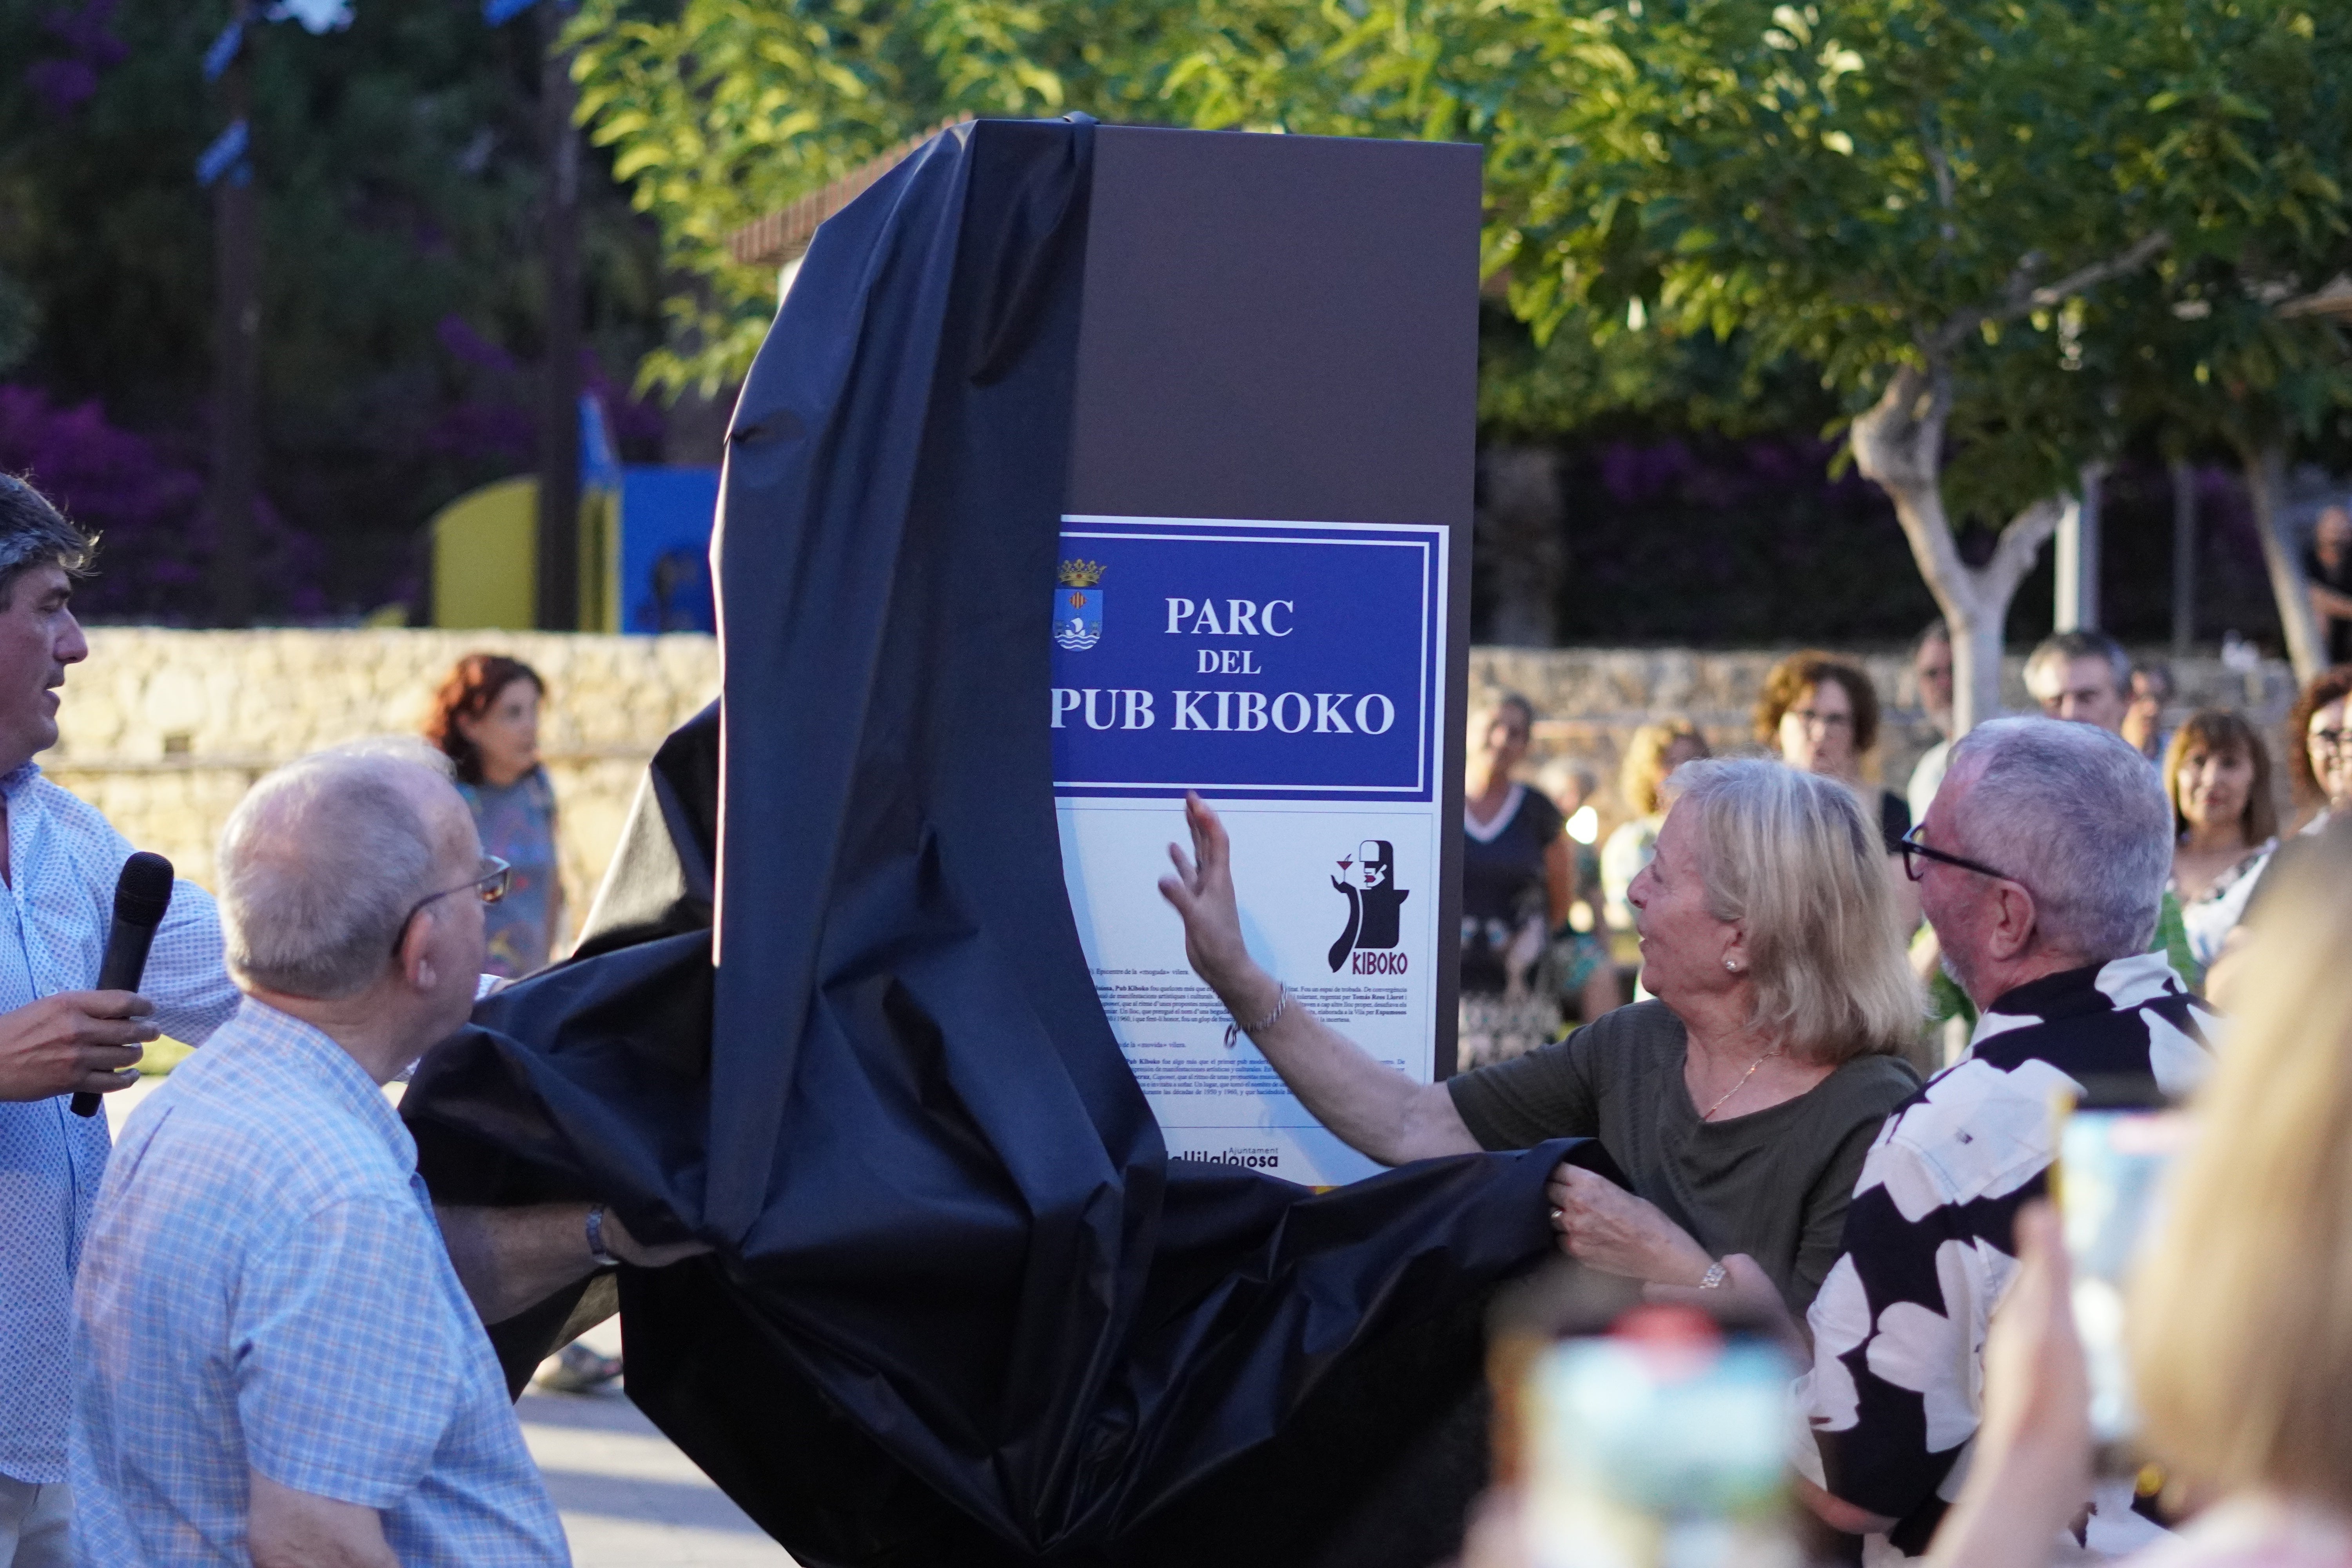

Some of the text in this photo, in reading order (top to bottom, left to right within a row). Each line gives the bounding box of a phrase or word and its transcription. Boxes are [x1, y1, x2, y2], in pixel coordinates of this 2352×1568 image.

[1165, 598, 1294, 637] PARC
[1196, 650, 1261, 675] DEL
[1051, 688, 1395, 735] PUB KIBOKO
[1352, 952, 1408, 975] KIBOKO
